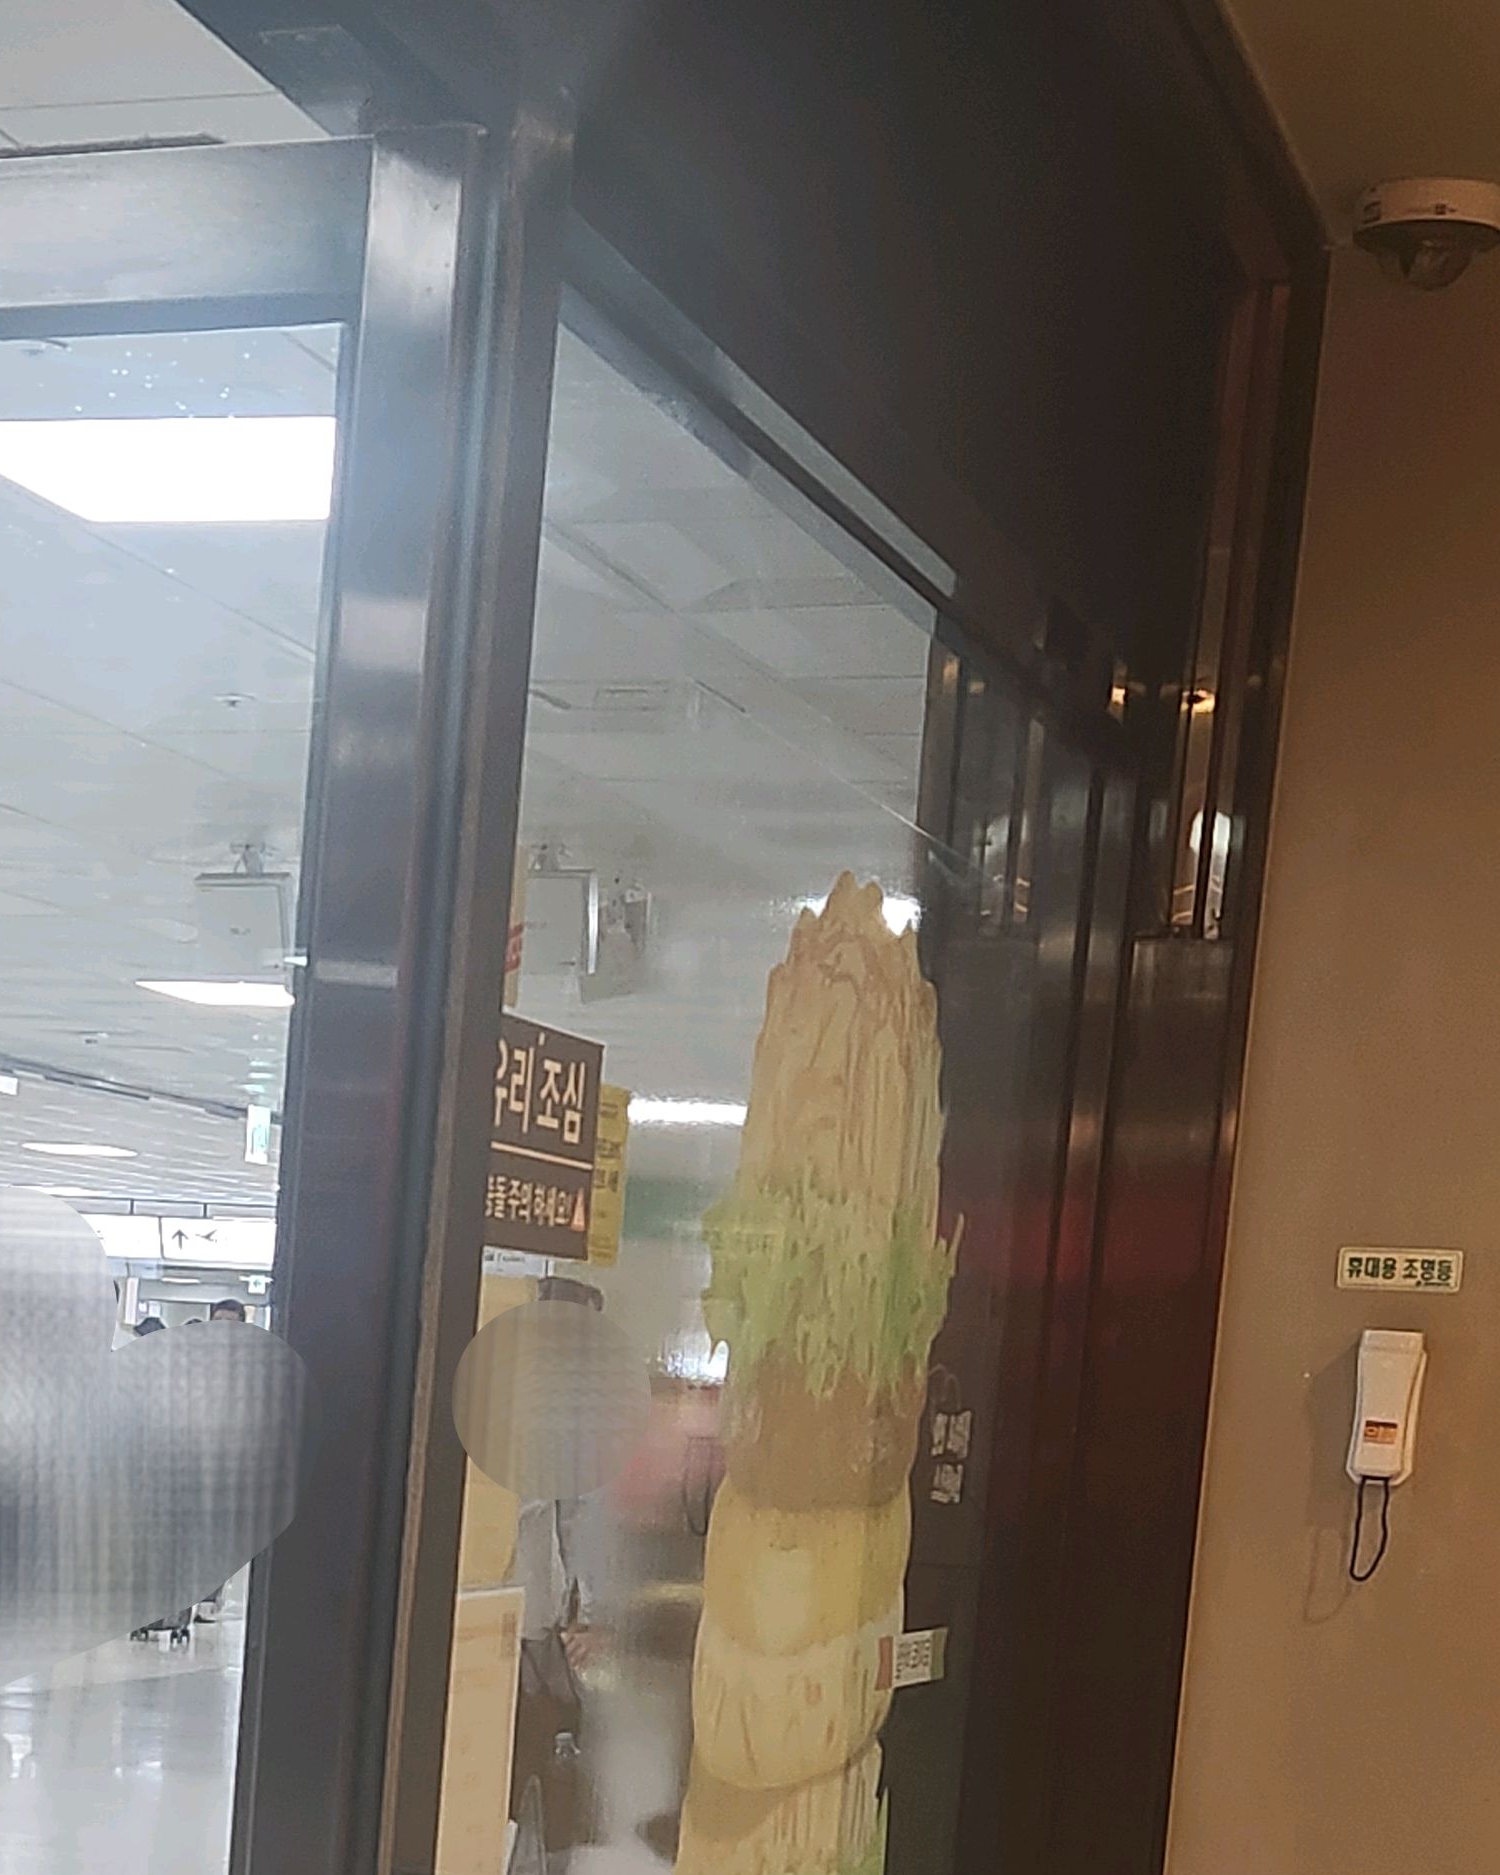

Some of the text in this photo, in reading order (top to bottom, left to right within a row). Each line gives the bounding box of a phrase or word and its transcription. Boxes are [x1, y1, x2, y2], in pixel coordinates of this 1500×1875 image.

[536, 1058, 586, 1144] 조심
[1347, 1256, 1453, 1282] 휴대용 조명등
